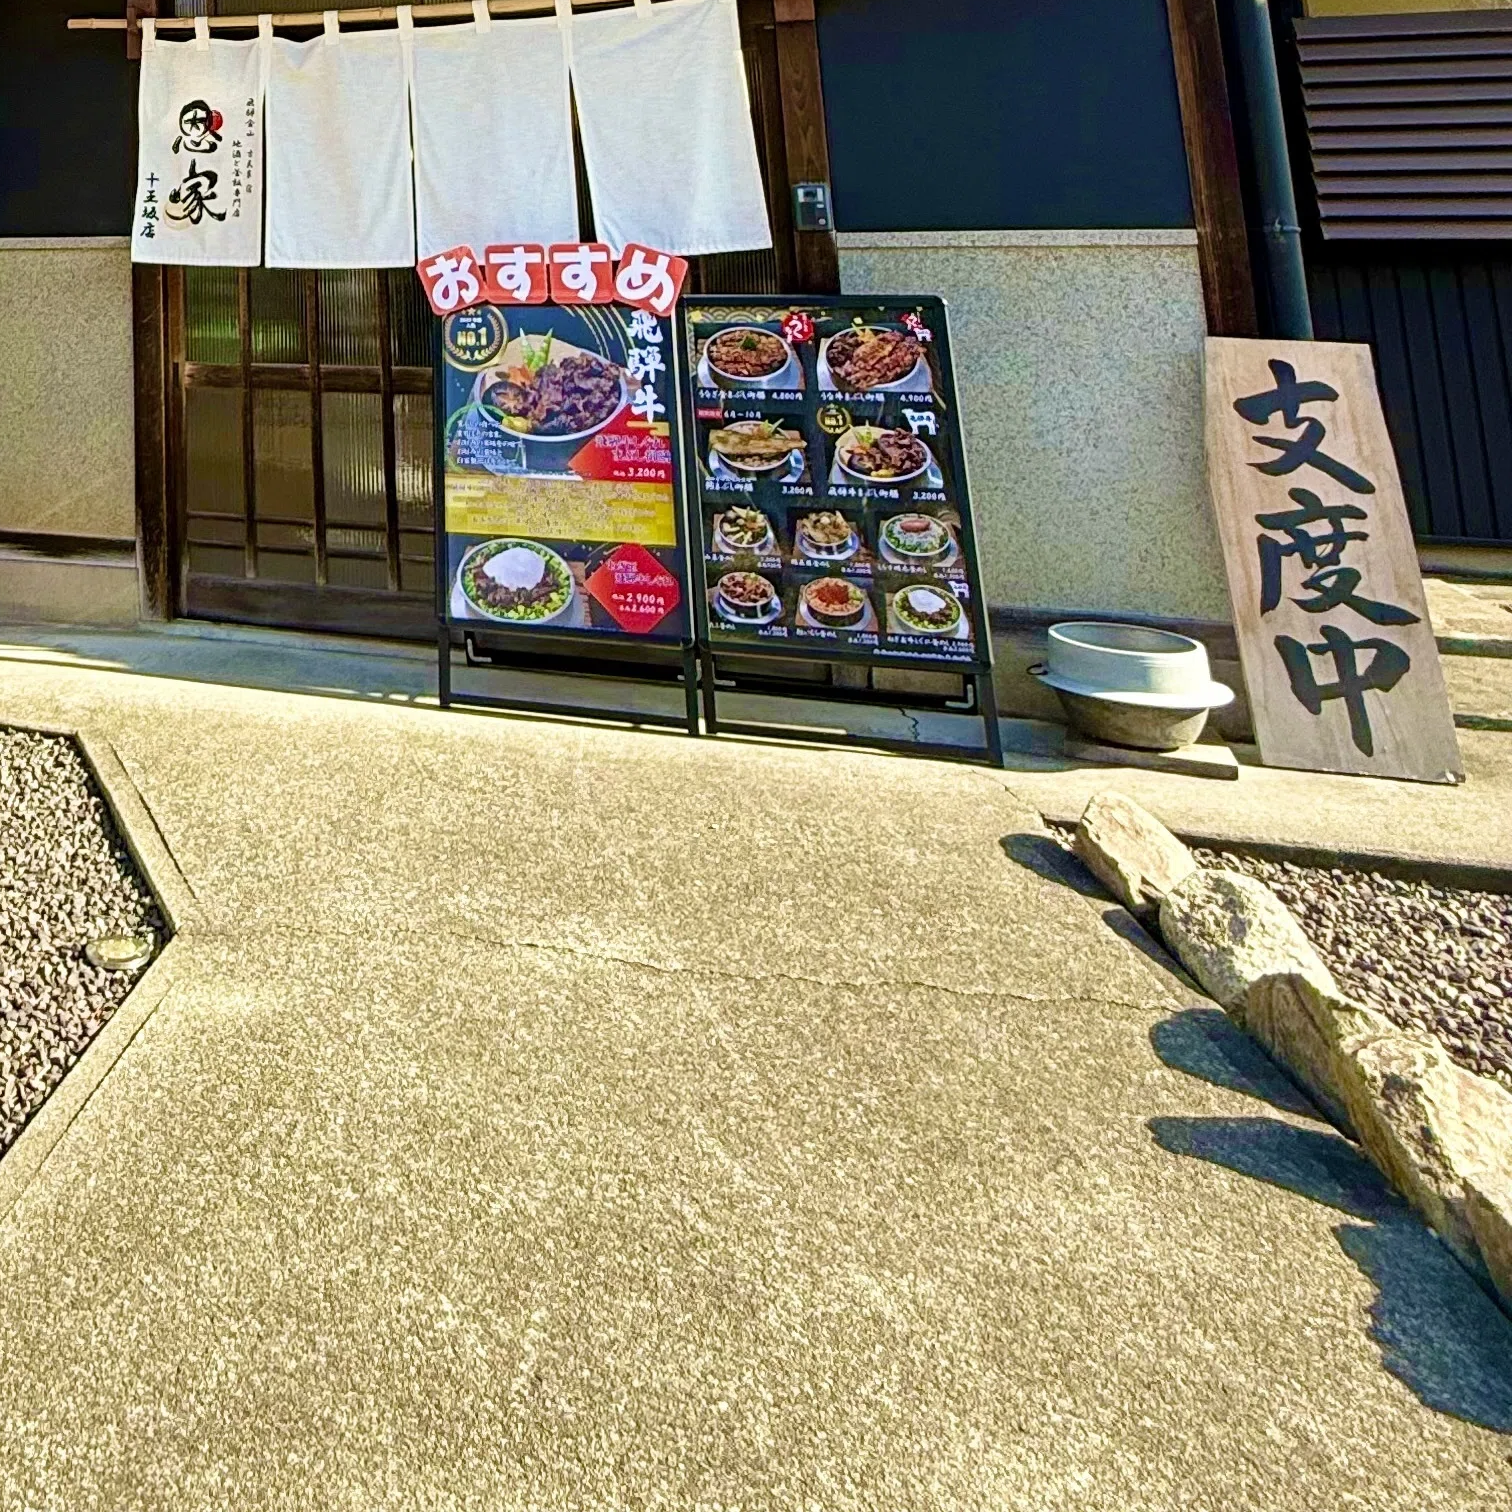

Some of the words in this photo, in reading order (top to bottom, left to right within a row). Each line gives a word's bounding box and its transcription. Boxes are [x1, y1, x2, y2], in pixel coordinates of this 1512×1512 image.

[140, 172, 160, 238] 十王坂店
[165, 99, 227, 225] 恩家
[426, 245, 675, 313] おすすめ
[626, 310, 667, 423] 飛騨牛
[1232, 358, 1421, 758] 支度中
